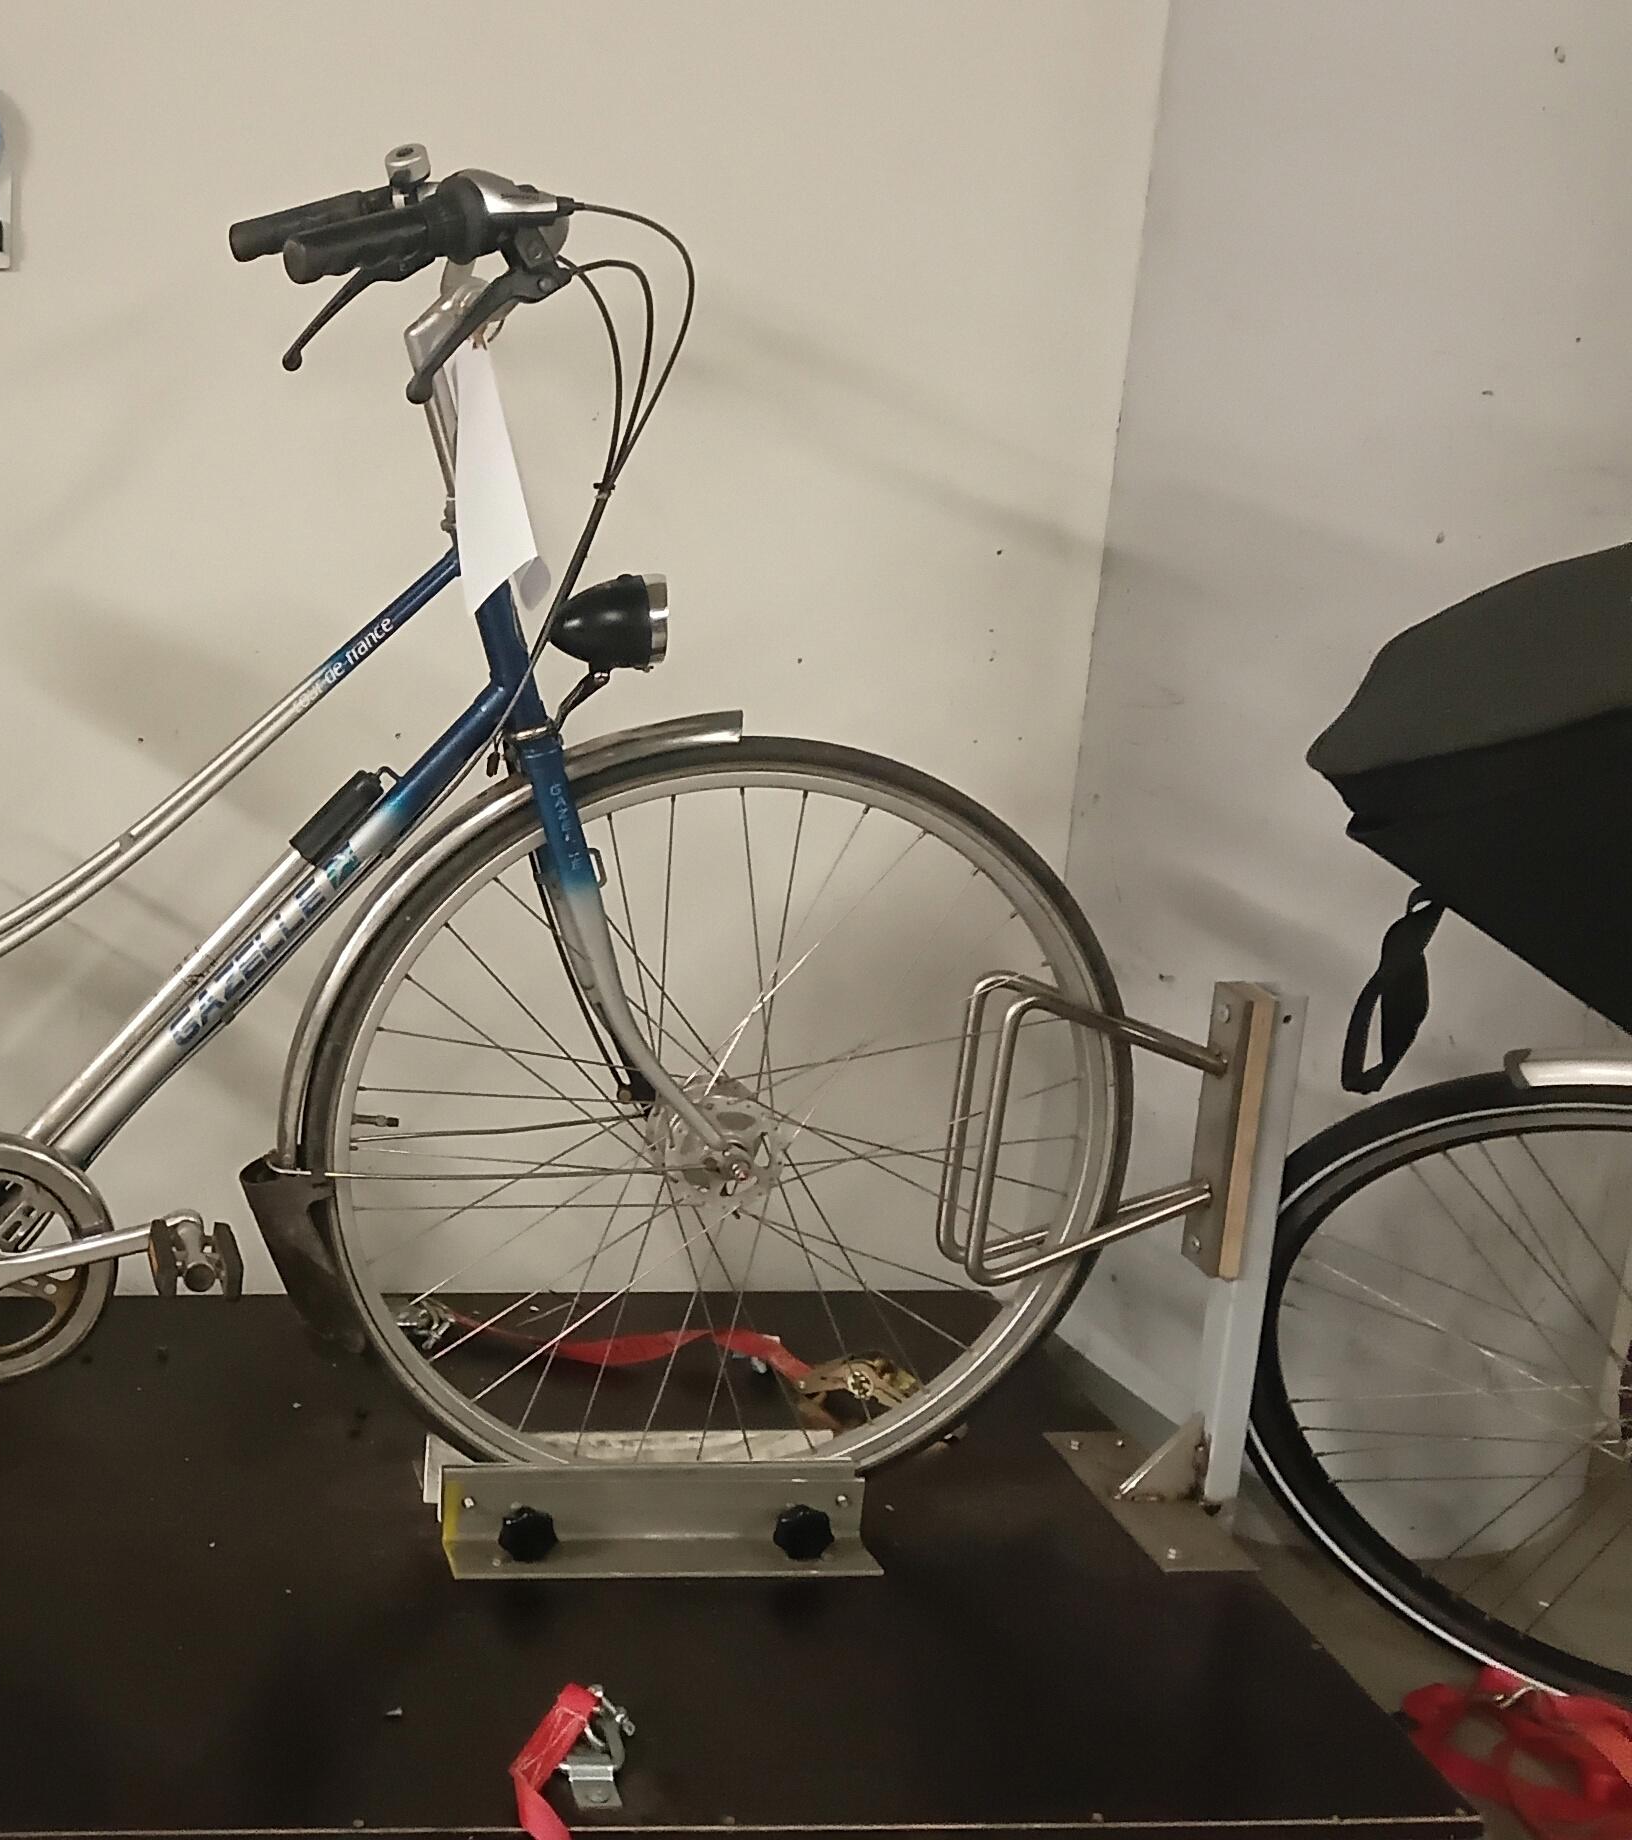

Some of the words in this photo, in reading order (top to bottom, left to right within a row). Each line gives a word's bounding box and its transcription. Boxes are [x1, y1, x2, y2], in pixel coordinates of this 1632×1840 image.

[324, 661, 346, 684] de
[342, 617, 394, 666] france
[549, 783, 583, 871] GAZEE
[170, 877, 327, 1046] GAZELLE
